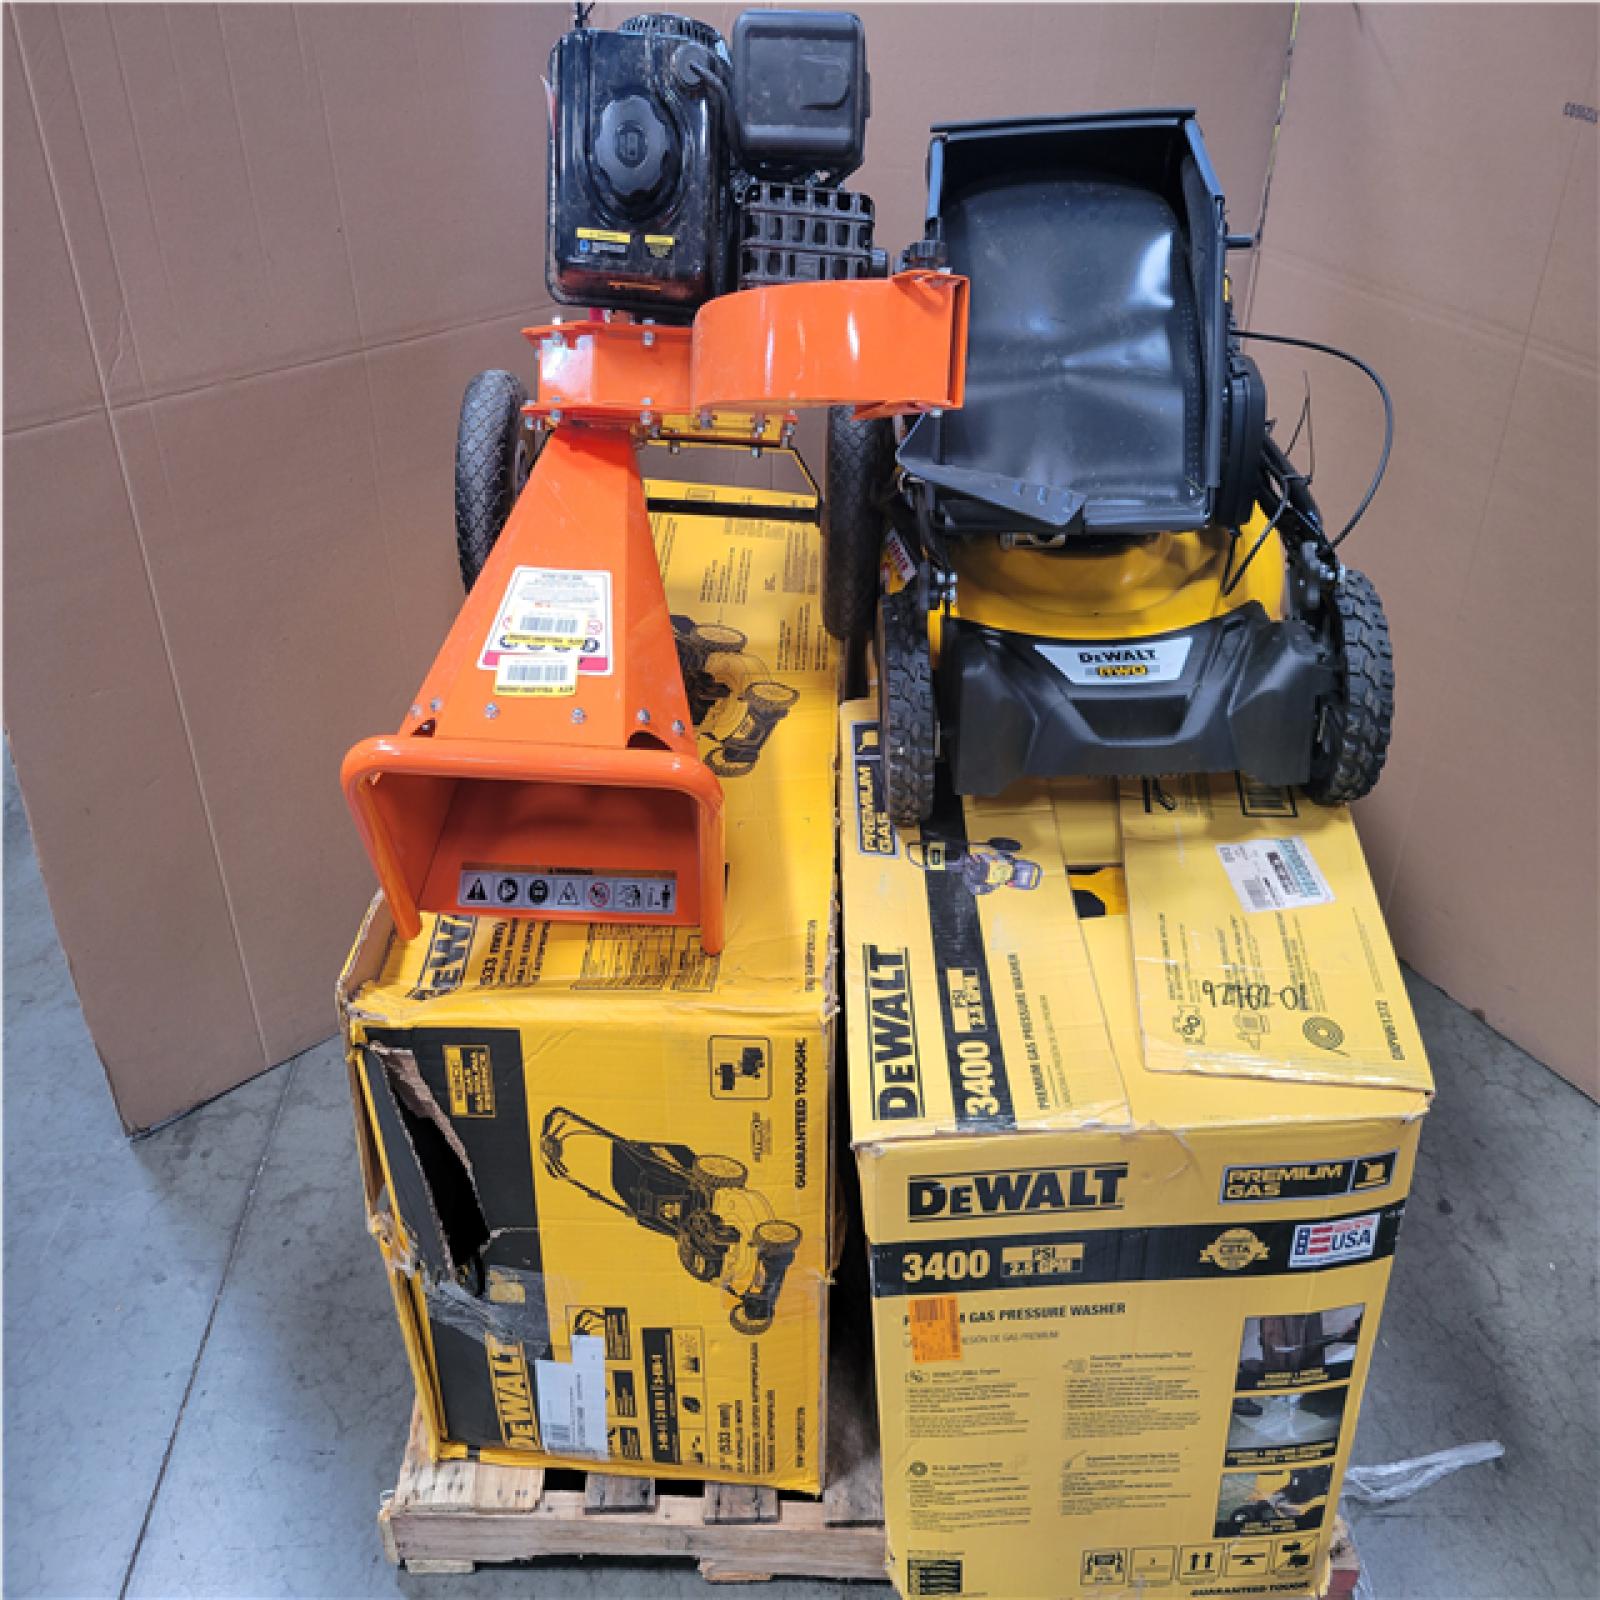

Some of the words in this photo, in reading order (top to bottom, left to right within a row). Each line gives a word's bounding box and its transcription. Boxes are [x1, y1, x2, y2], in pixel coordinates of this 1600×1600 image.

[857, 767, 876, 850] PREMIUM
[1007, 953, 1025, 990] WASHER
[869, 945, 918, 1120] DEWALT
[1015, 992, 1035, 1040] PRESSURE
[1024, 1042, 1040, 1060] GAS
[957, 1039, 1001, 1115] 3400
[1030, 1064, 1050, 1110] PREMIUM
[795, 1098, 806, 1188] GUARANTEED
[910, 1168, 1128, 1215] DEWALT
[1227, 1184, 1280, 1198] GAS
[1229, 1164, 1343, 1184] PREMIUM
[1033, 1246, 1055, 1259] PSI
[1332, 1229, 1370, 1250] USA
[902, 1250, 991, 1284] 3400
[969, 1310, 995, 1323] GAS
[1000, 1305, 1066, 1321] PRESSURE
[1070, 1303, 1126, 1316] WASHER
[1191, 1585, 1265, 1597] GUARANTEED
